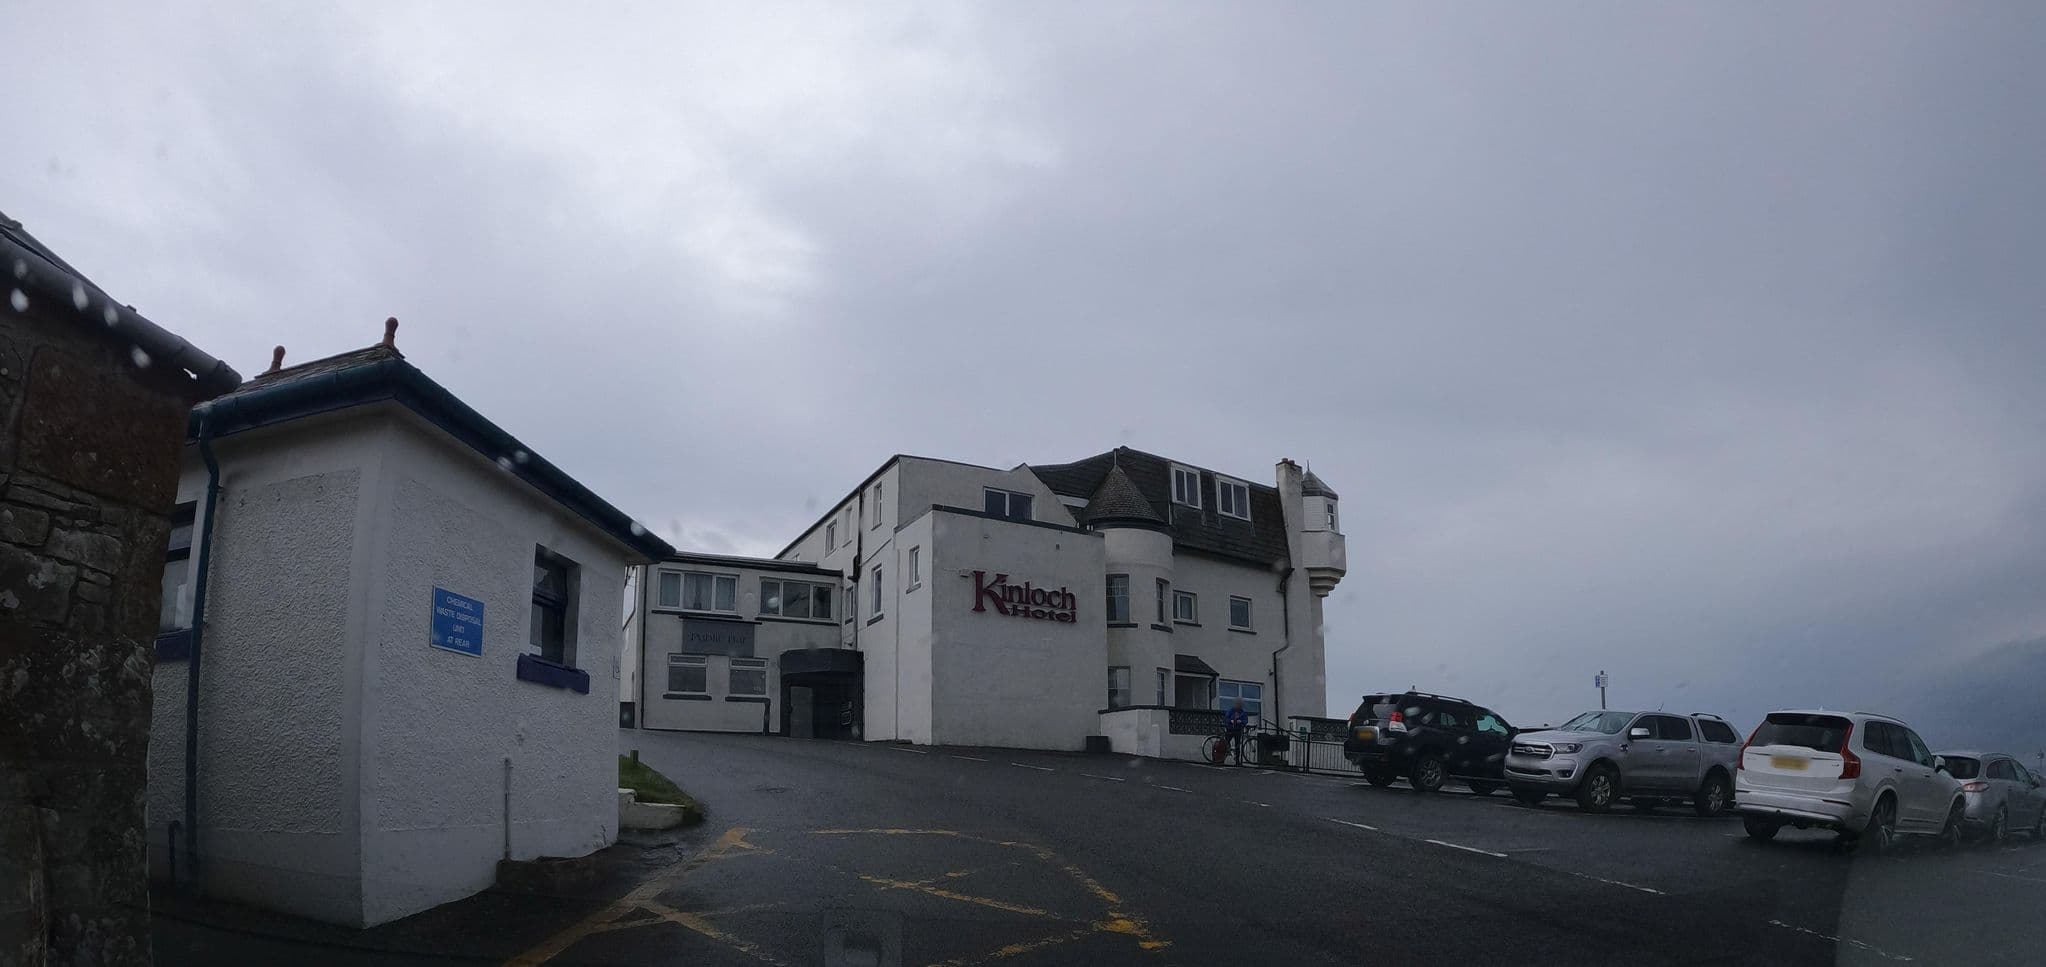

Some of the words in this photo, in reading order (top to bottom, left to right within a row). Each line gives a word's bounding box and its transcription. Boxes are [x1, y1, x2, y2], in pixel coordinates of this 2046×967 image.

[972, 570, 1076, 615] Kinloch
[447, 596, 473, 610] CHEMICAL
[437, 607, 455, 618] WASTE
[456, 612, 481, 626] DISPOSAL
[1011, 604, 1077, 623] Hotel
[452, 624, 465, 634] UNIT
[447, 636, 453, 645] AT
[454, 637, 470, 649] REAR
